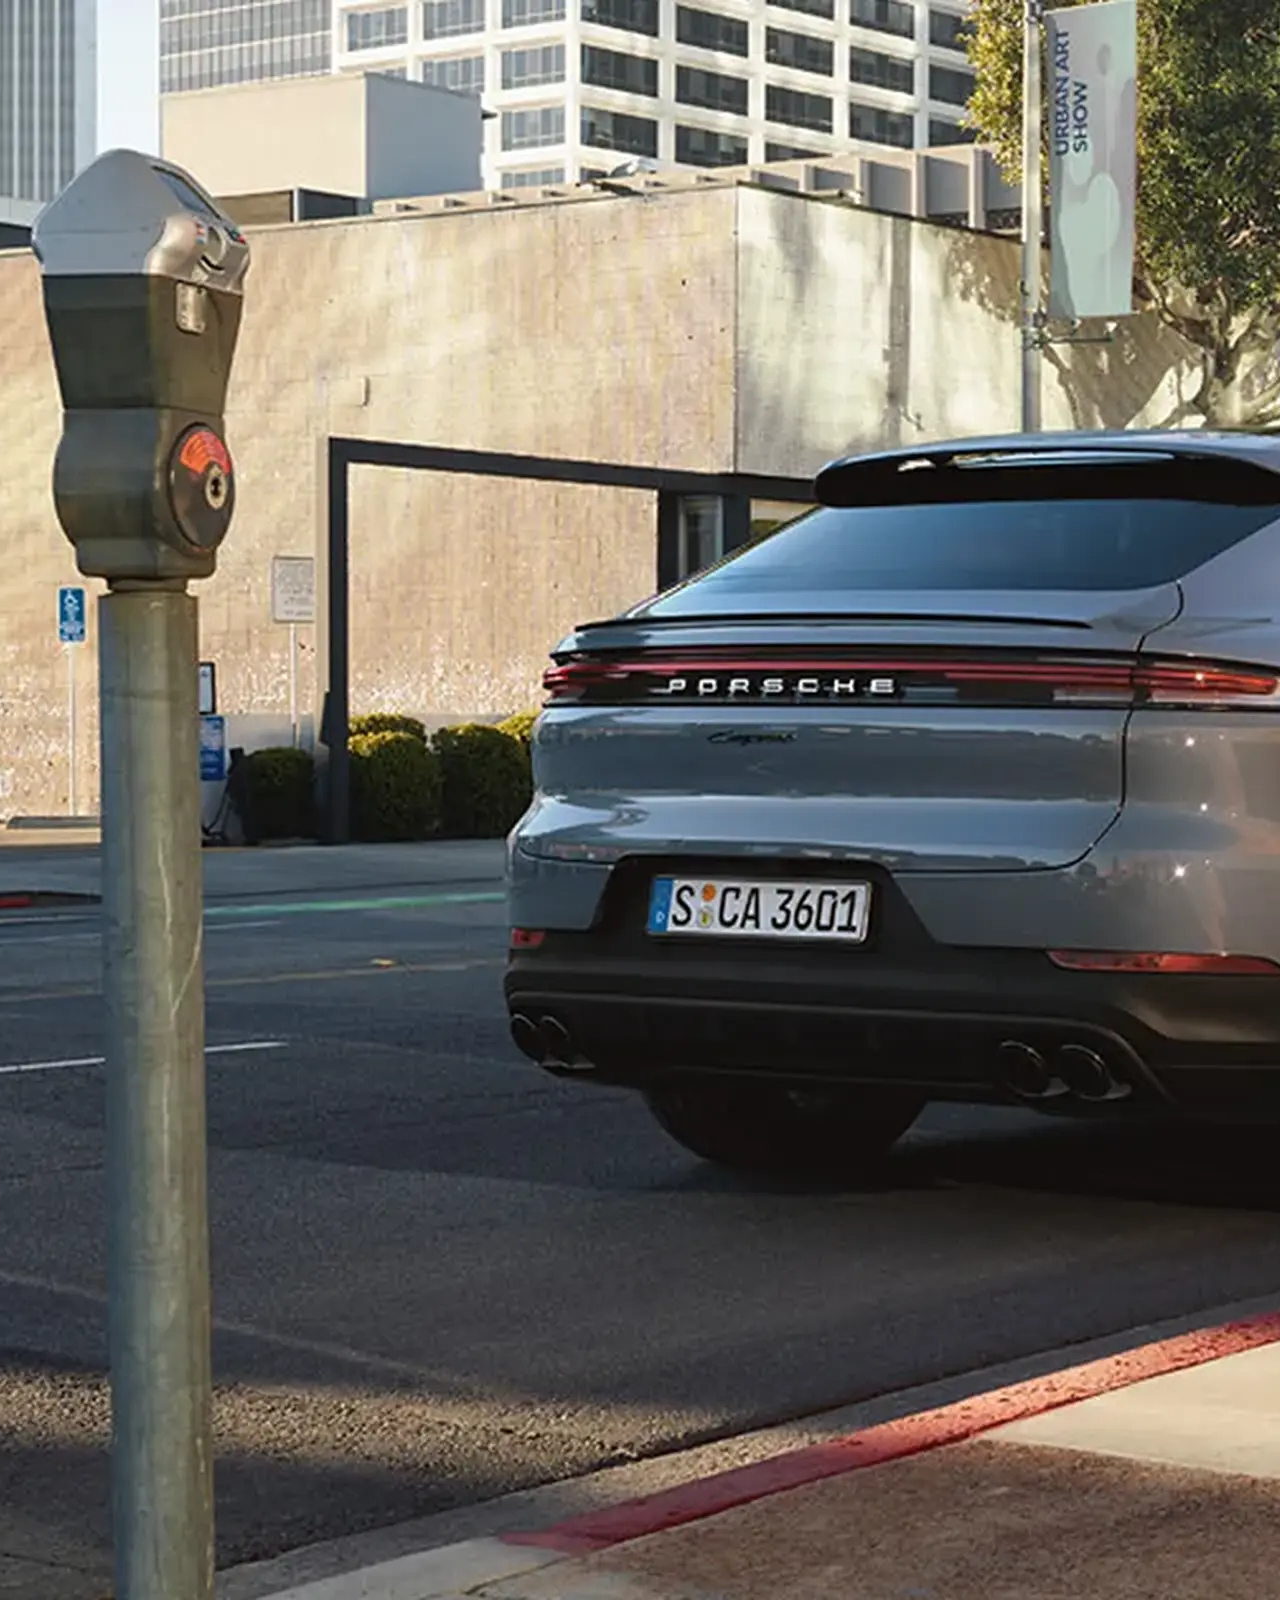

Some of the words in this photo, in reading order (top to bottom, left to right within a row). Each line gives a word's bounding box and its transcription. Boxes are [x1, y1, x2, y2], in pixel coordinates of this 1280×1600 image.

[1055, 30, 1069, 73] ART
[1055, 76, 1070, 157] URBAN
[1072, 81, 1088, 153] SHOW
[668, 678, 894, 694] PORSCHE
[671, 884, 696, 927] S
[718, 886, 761, 930] CA
[770, 888, 858, 933] 3601
